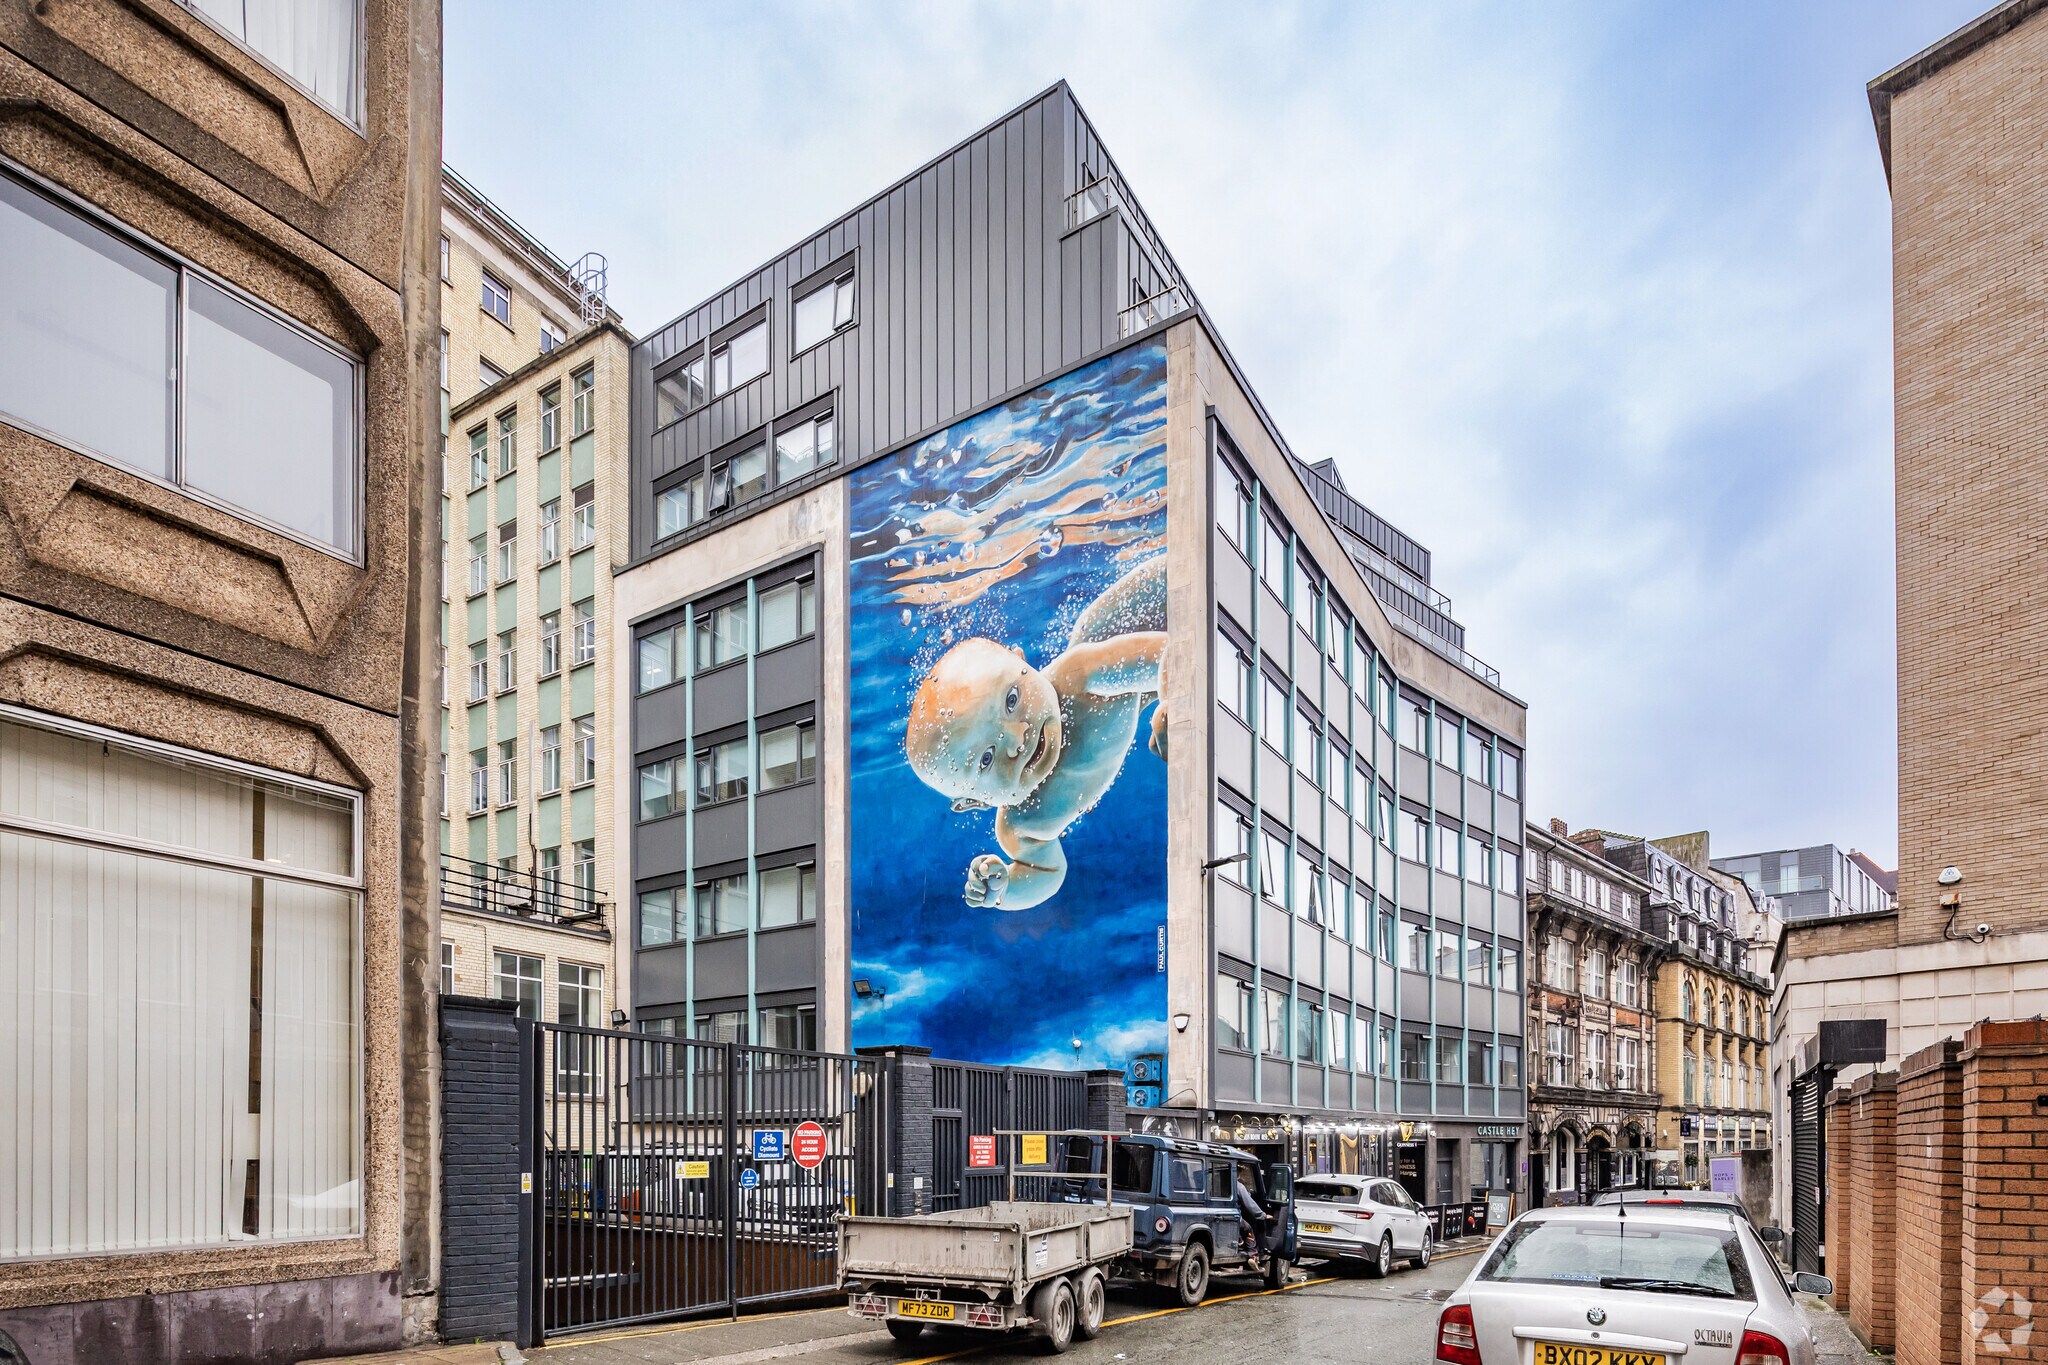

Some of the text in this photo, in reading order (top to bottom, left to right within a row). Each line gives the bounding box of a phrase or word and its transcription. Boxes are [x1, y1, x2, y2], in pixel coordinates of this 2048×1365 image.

[1477, 1126, 1520, 1136] CASTLE HEY
[902, 1302, 950, 1317] MF73 ZDR
[1694, 1329, 1732, 1344] OCTAVIA
[1544, 1345, 1602, 1365] BX02
